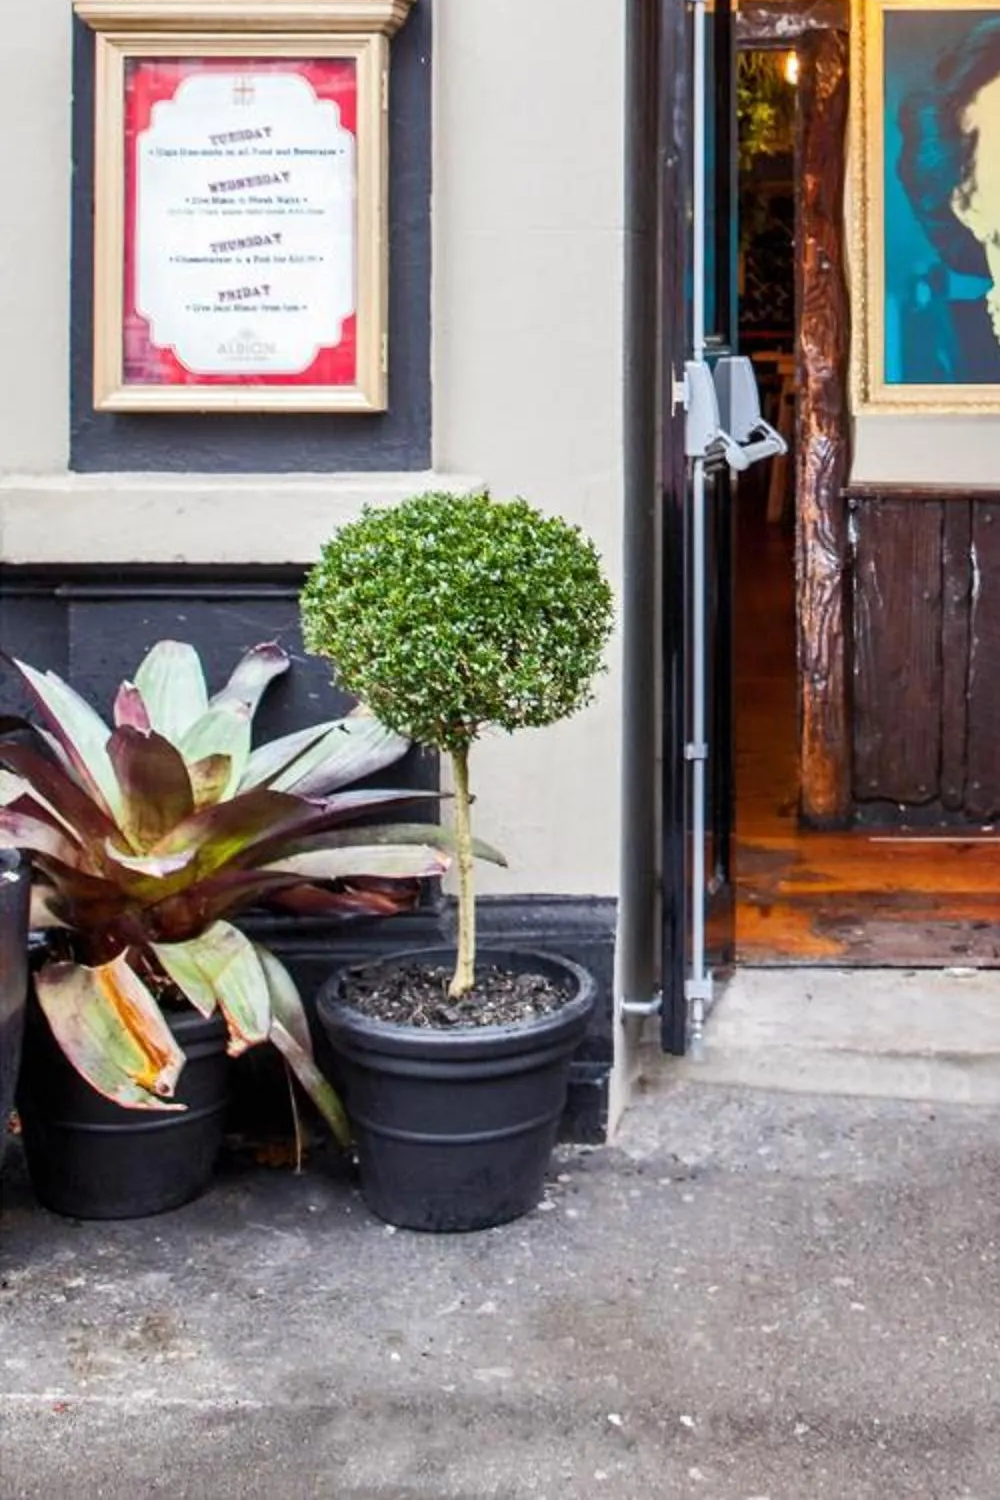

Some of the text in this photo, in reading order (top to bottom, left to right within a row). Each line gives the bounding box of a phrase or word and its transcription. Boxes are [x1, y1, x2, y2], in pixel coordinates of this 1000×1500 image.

[208, 125, 272, 146] TUESDAY
[208, 170, 290, 193] WEDNESDAY
[210, 232, 282, 253] THURSDAY
[218, 283, 272, 302] FRIDAY
